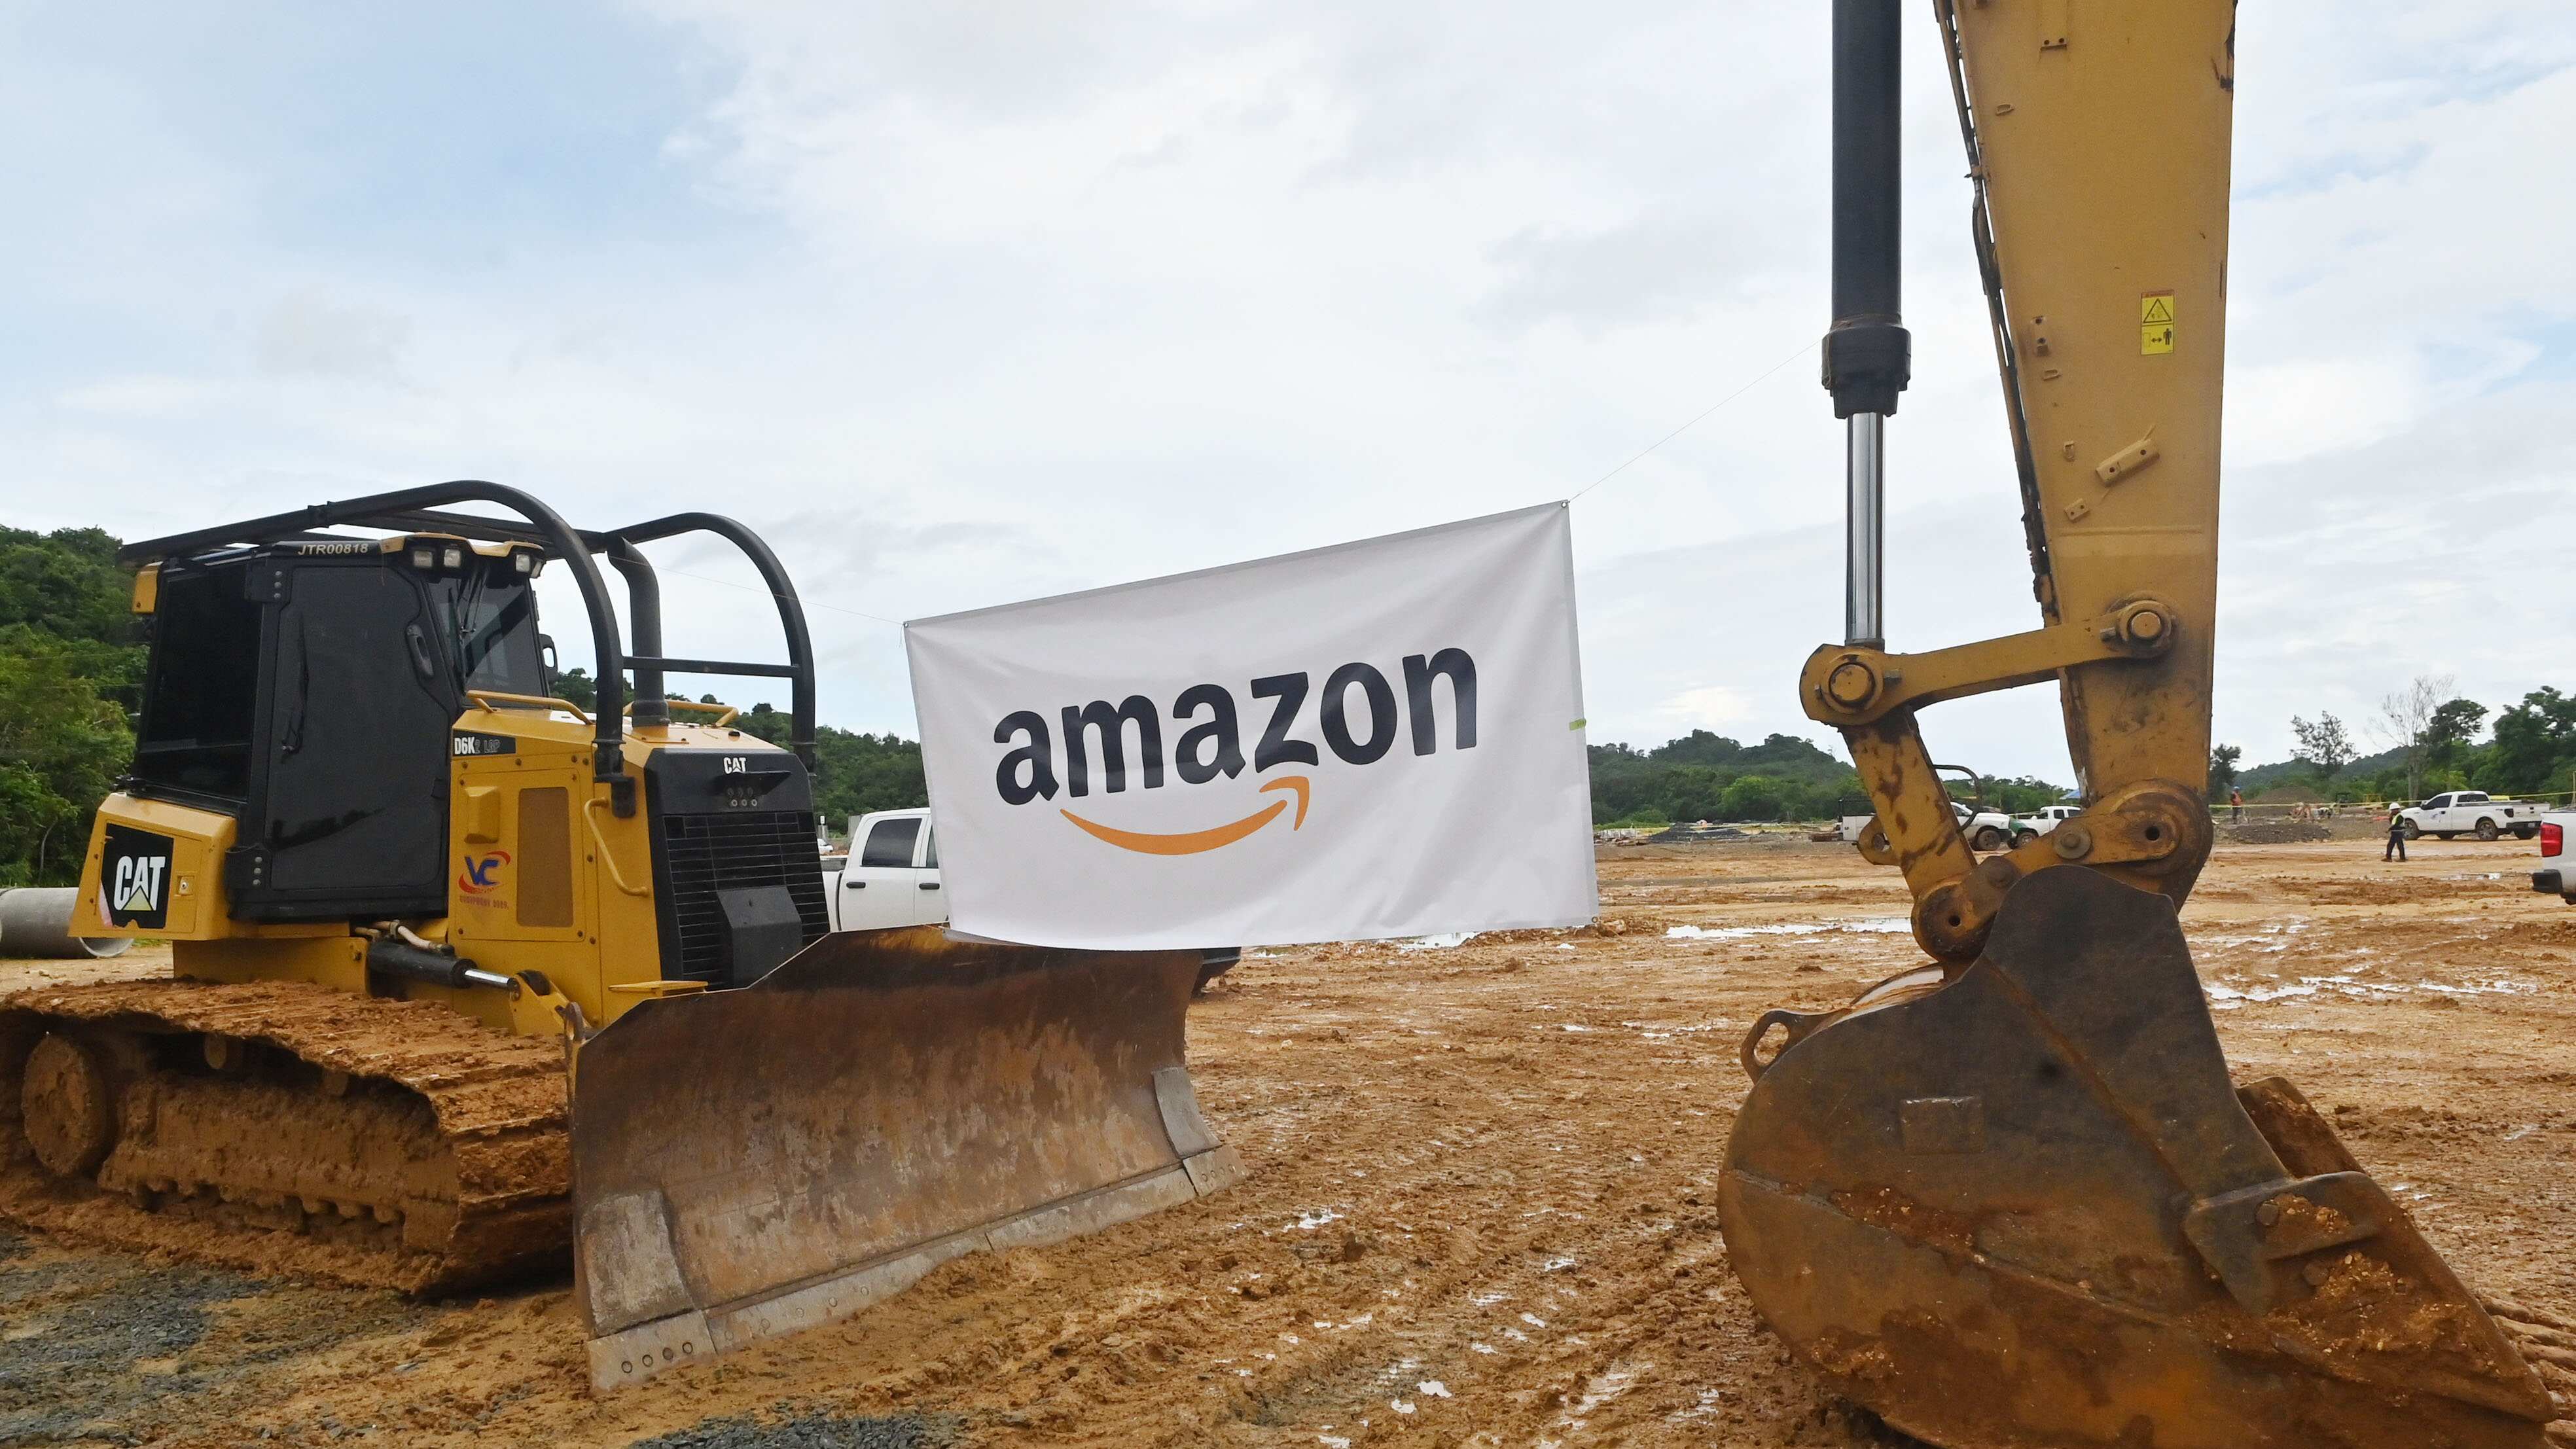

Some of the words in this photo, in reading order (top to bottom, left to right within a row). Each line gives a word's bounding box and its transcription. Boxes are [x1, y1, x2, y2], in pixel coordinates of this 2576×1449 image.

[298, 544, 368, 555] JTR00818
[993, 647, 1477, 806] amazon
[723, 757, 746, 774] CAT
[113, 855, 166, 911] CAT
[464, 856, 500, 885] VC
